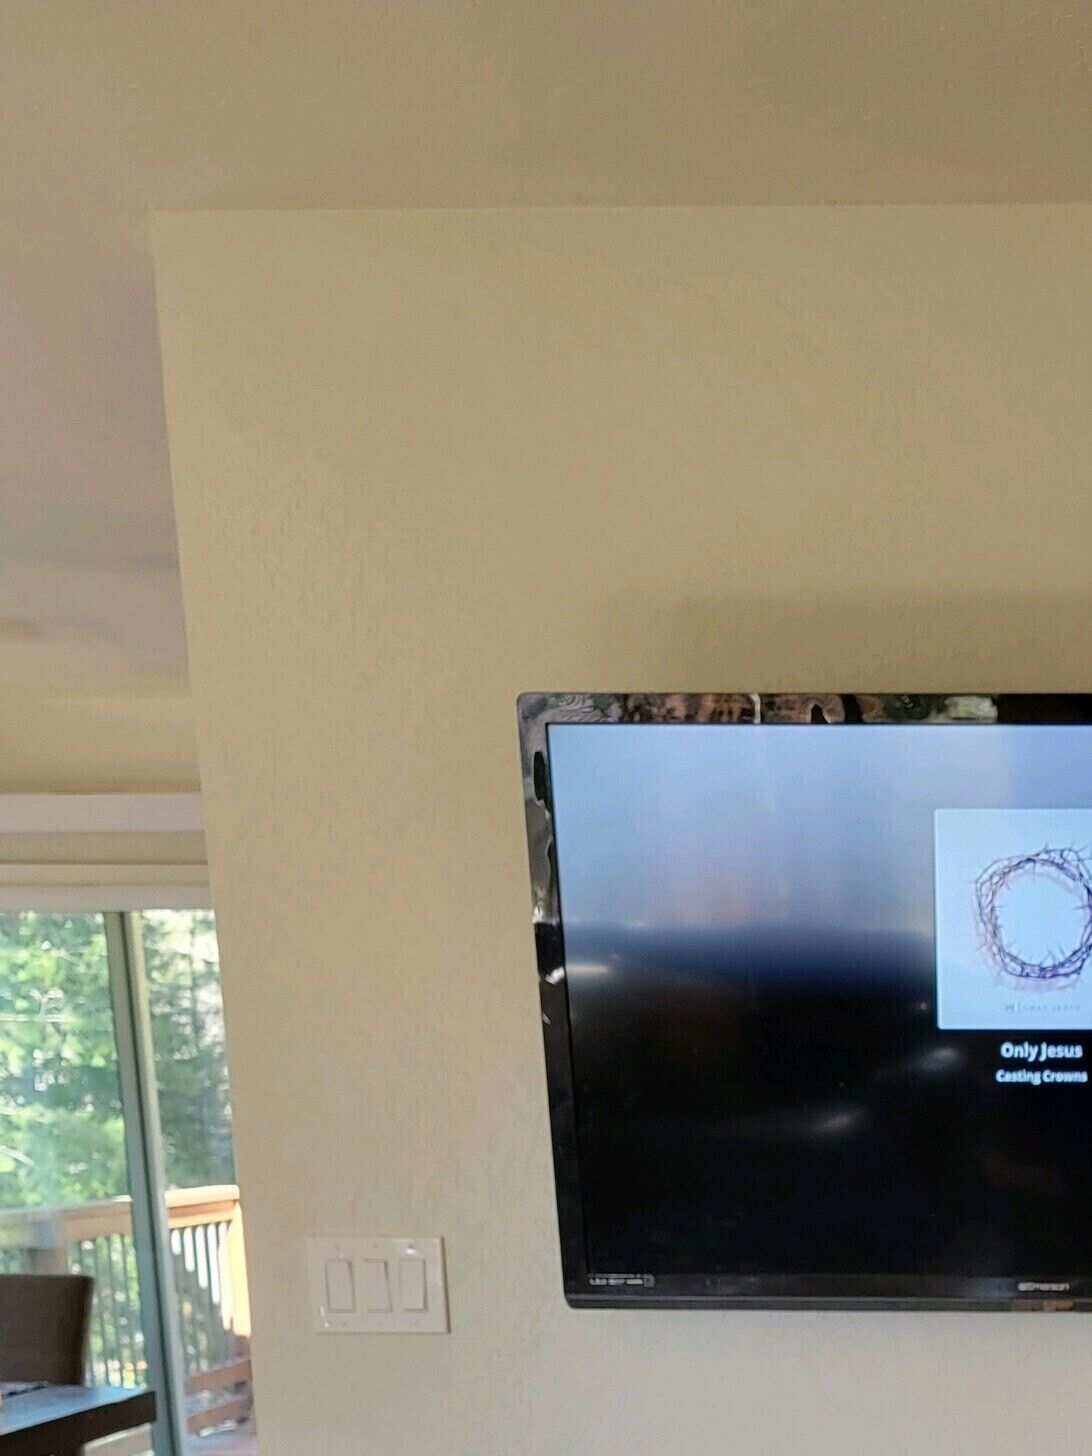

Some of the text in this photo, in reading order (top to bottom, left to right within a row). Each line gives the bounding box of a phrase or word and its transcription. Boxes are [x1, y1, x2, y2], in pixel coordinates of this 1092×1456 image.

[1000, 1041, 1083, 1062] Only Jesus
[995, 1068, 1088, 1086] Casting Crowns
